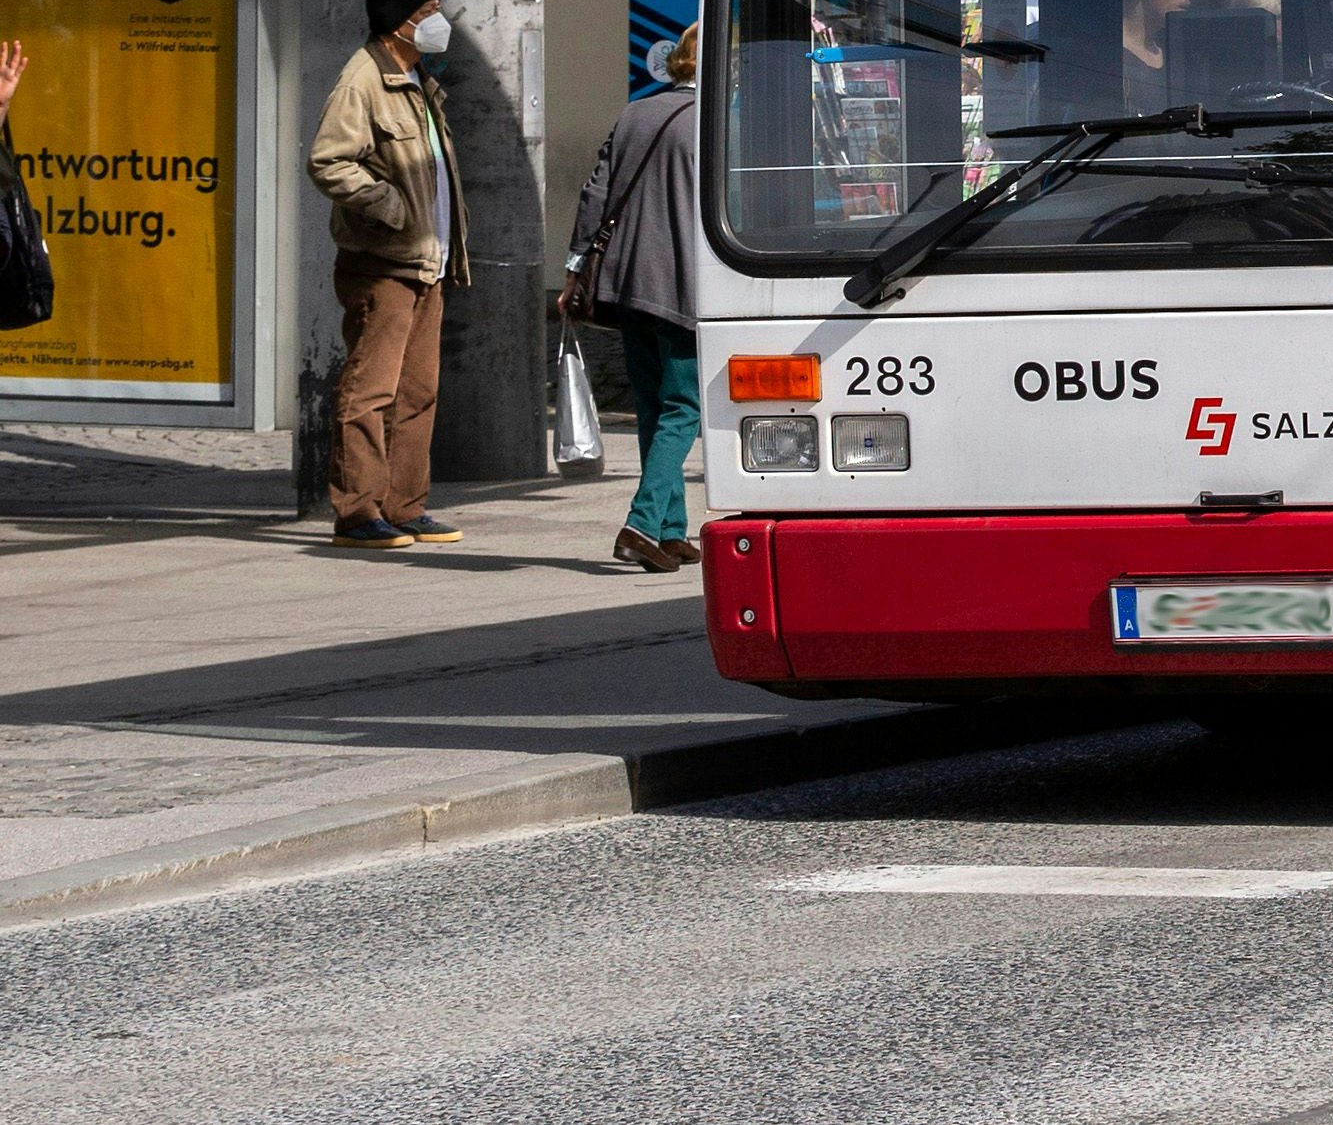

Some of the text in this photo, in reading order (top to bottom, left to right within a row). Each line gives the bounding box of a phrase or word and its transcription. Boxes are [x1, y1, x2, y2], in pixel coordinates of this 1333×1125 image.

[137, 41, 176, 53] Wilfried
[178, 42, 221, 53] Haslauer
[845, 355, 936, 396] 283
[1013, 359, 1161, 402] OBUS
[1124, 619, 1134, 632] A
